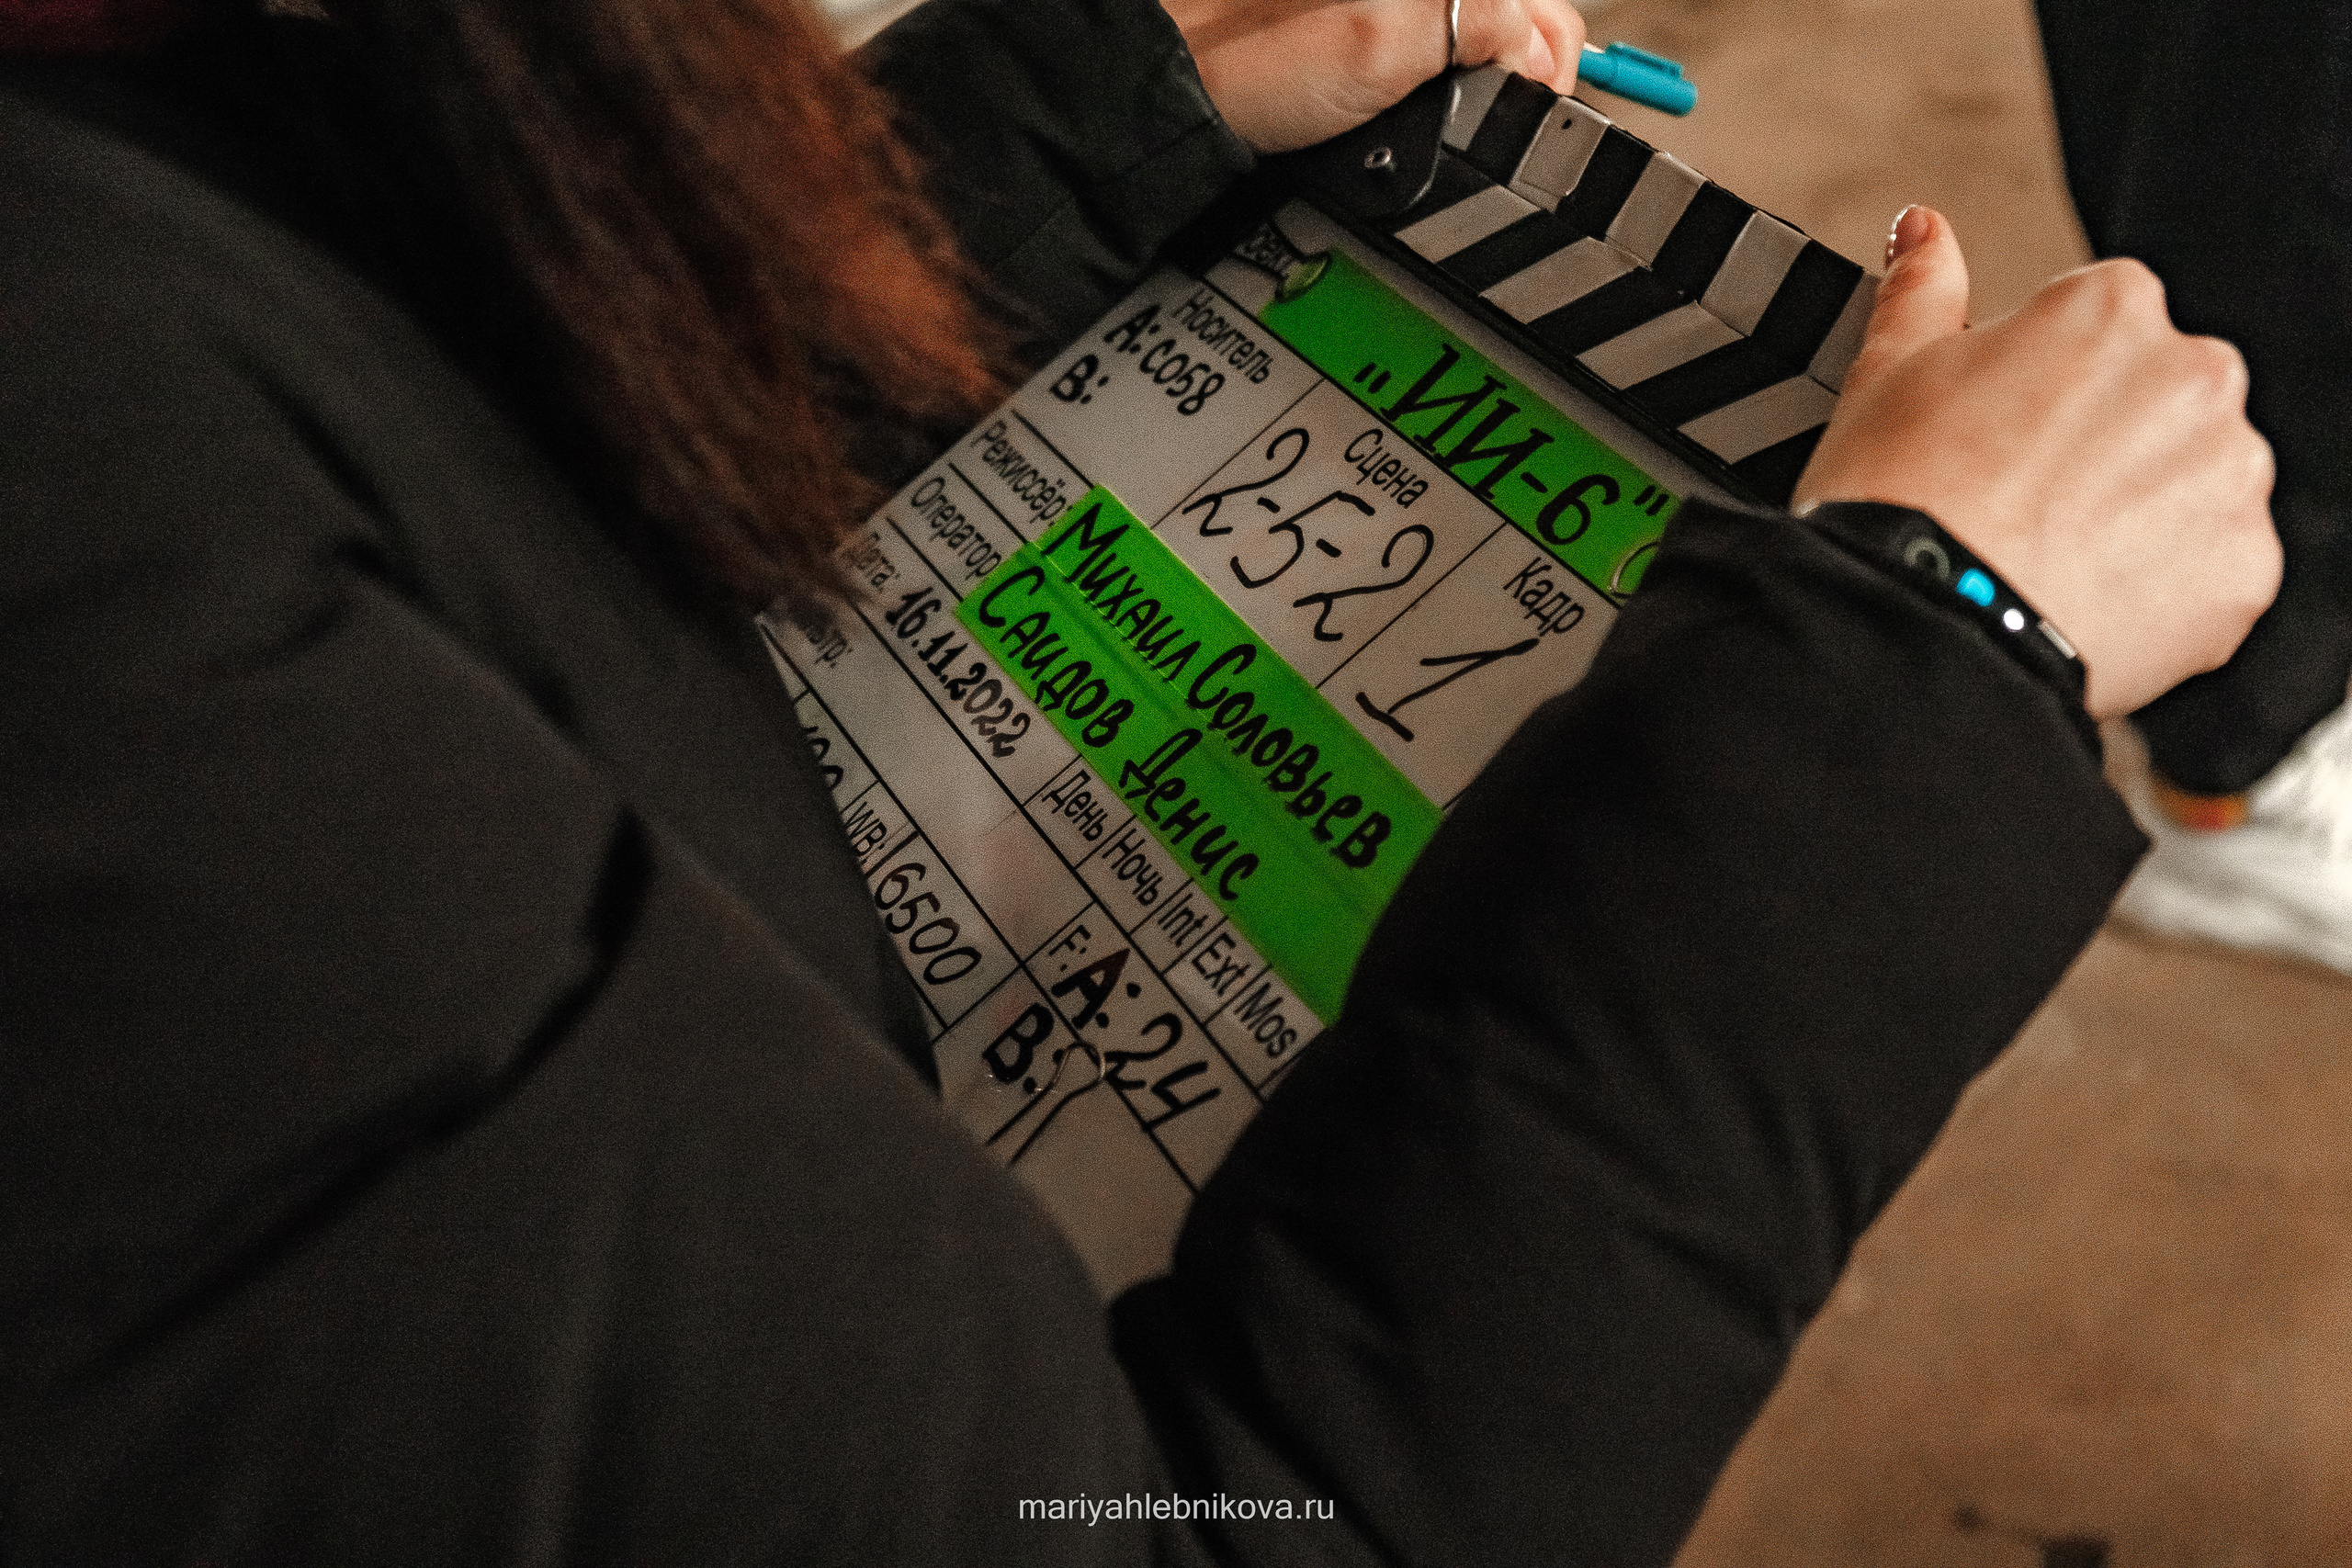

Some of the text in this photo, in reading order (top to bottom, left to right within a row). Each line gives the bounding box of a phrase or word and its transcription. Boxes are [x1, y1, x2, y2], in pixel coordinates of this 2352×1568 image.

[1048, 354, 1109, 405] B:
[1170, 288, 1273, 384] Носитель
[1344, 428, 1429, 508] Сцена
[910, 477, 1001, 581] Оператор
[1182, 428, 1434, 641] 2-5-2
[1503, 557, 1585, 637] Кадр
[884, 586, 1031, 758] 16.11.2022
[1355, 638, 1540, 742] 1
[1188, 643, 1393, 869] Соловьев
[1118, 728, 1259, 901] Денис
[874, 863, 982, 986] 6500
[1041, 769, 1297, 1059] День Ночь Int Ext Mos
[1048, 924, 1091, 972] F:
[982, 1002, 1066, 1094] B:
